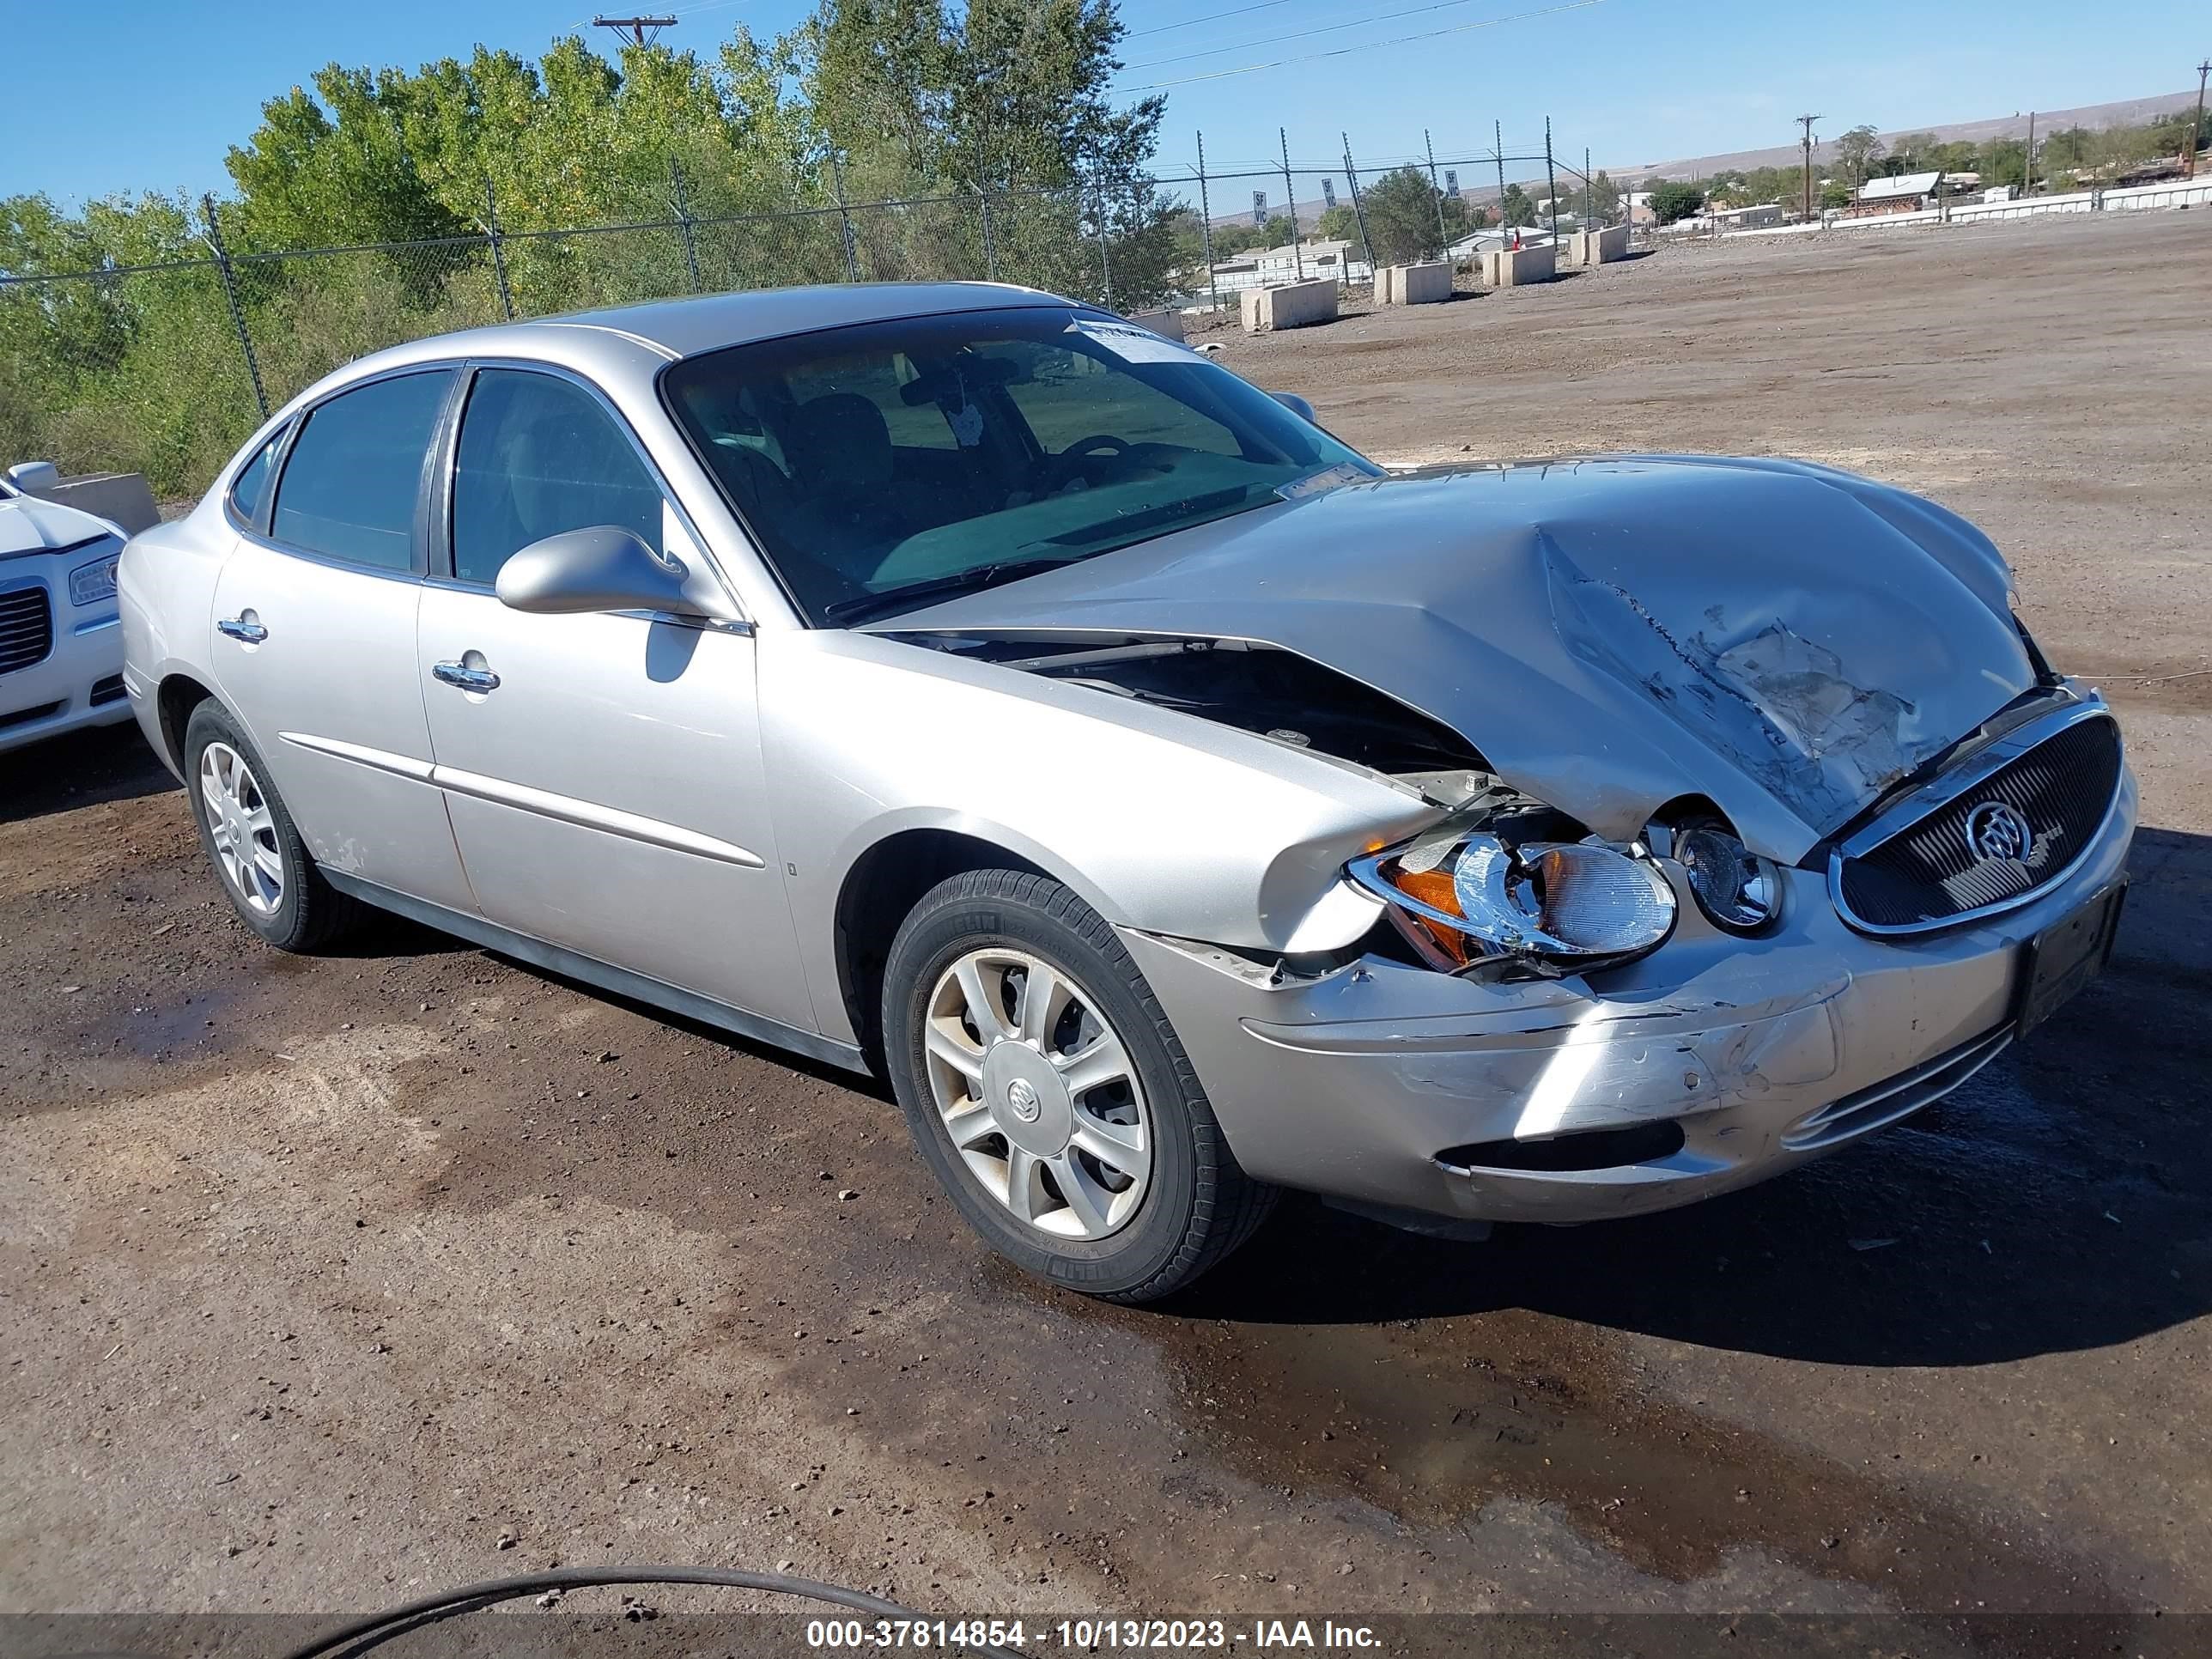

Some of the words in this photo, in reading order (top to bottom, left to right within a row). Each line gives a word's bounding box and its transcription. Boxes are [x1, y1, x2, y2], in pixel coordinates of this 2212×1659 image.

[1448, 173, 1455, 183] SF
[1255, 193, 1264, 207] SF
[1255, 210, 1267, 222] VIC
